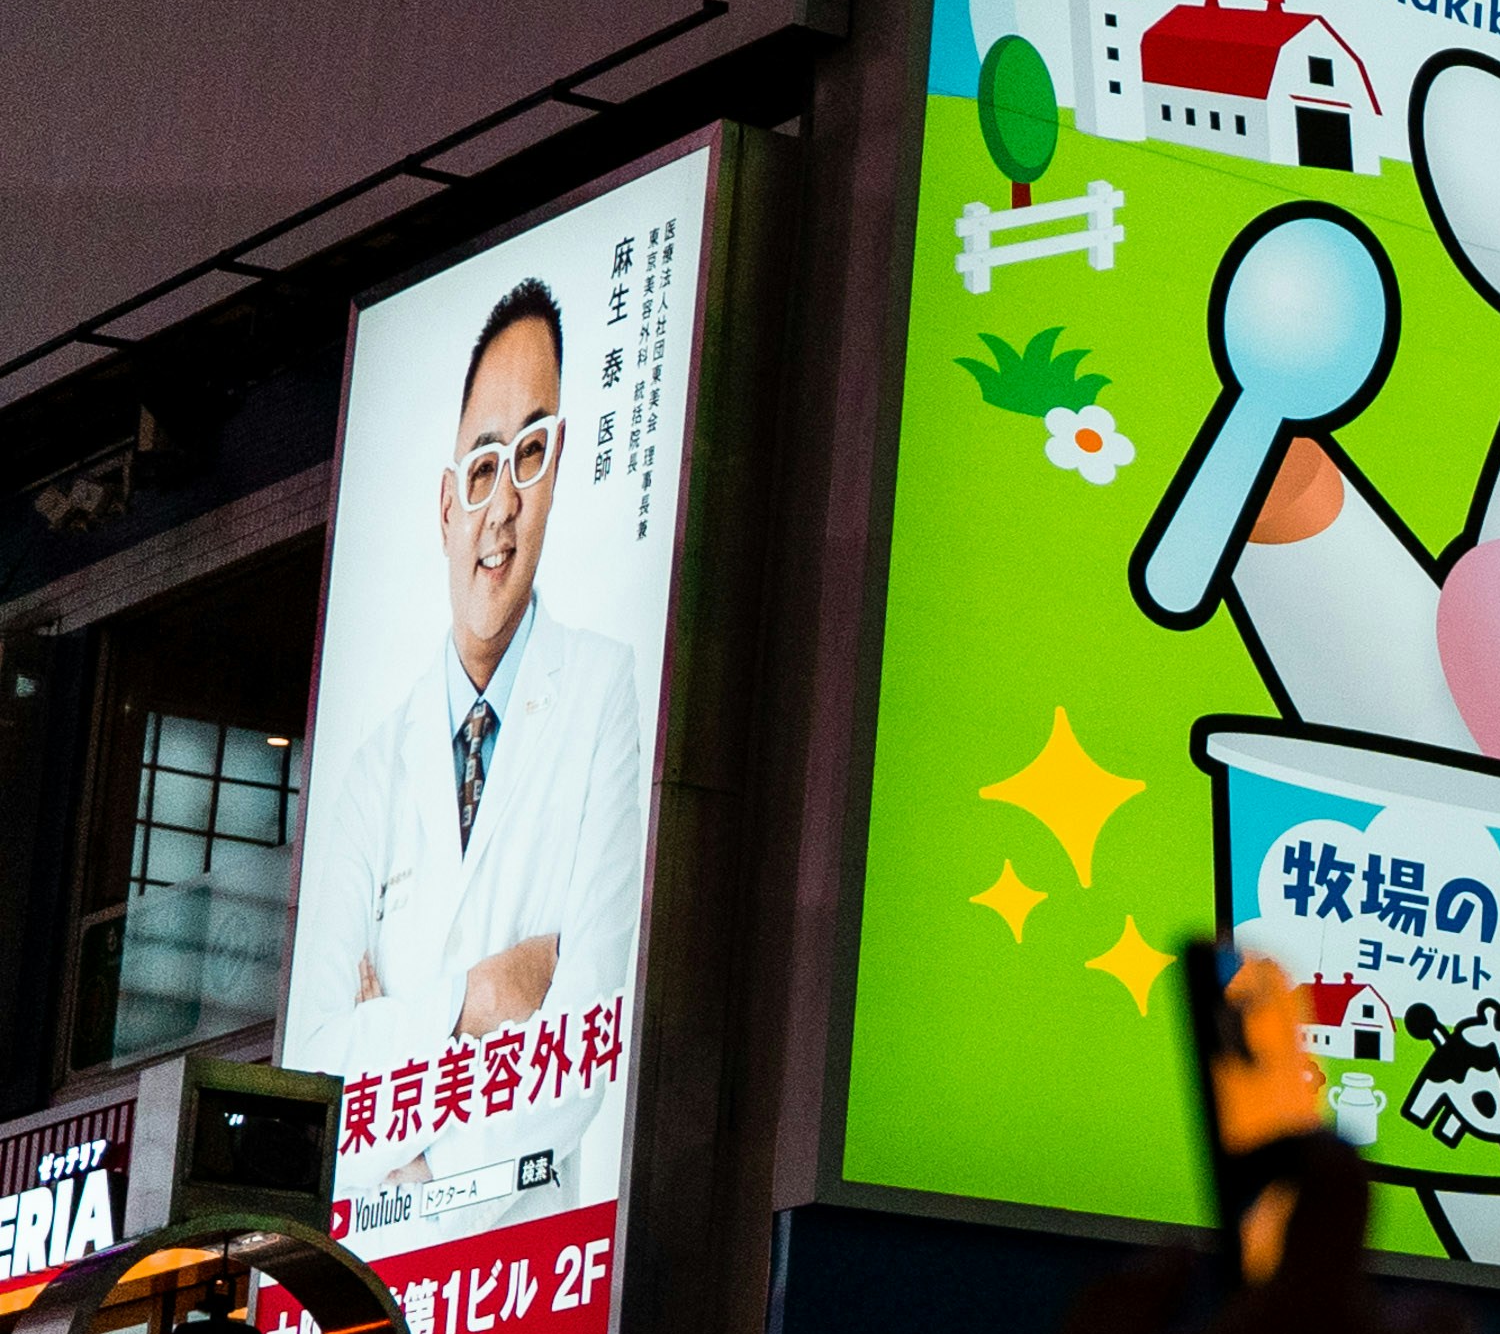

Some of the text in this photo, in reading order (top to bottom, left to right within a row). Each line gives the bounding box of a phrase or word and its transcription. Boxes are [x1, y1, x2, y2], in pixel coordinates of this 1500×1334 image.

[636, 227, 661, 368] 東京美容外科
[1357, 938, 1492, 991] ヨーグルト
[339, 995, 625, 1157] 東京美容外科
[38, 1139, 108, 1182] ゼッテリア
[354, 1188, 412, 1234] YouTube
[521, 1156, 550, 1185] 検索
[551, 1237, 611, 1314] 2F
